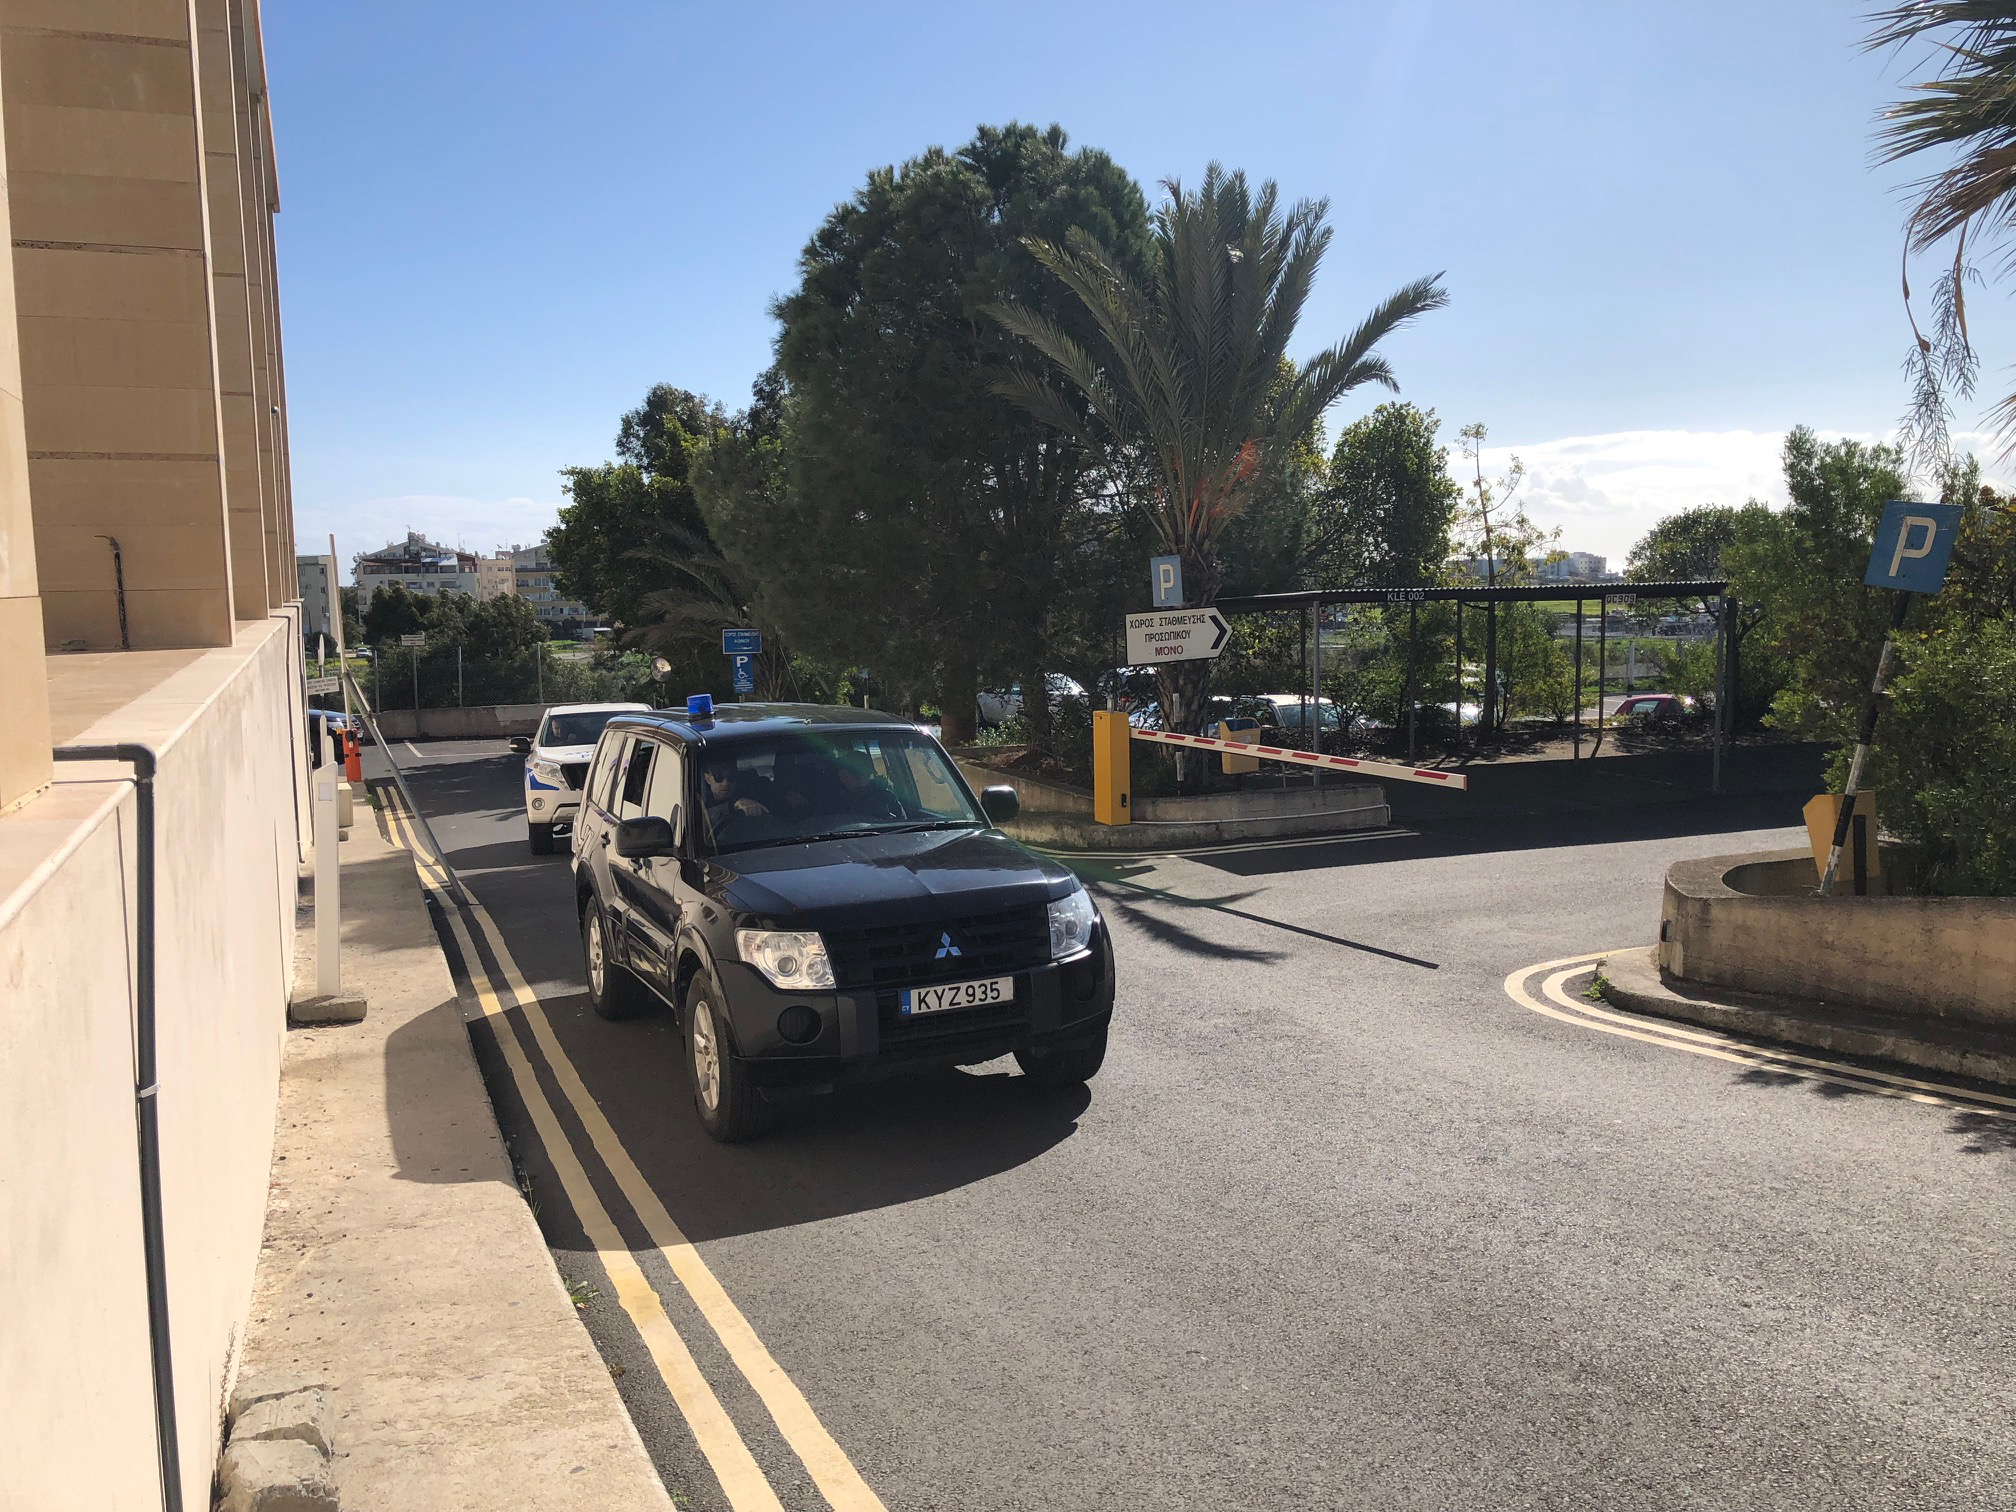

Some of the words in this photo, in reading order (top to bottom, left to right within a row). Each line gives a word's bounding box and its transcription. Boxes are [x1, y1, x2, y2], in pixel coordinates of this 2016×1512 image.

[1888, 515, 1937, 577] P
[1159, 564, 1174, 600] P
[1387, 592, 1406, 601] KLE
[1408, 591, 1425, 601] 002
[1129, 618, 1154, 629] ΧΩΡΟΣ
[1159, 614, 1206, 627] ΣΤΑΘΜΕΥΣΗΣ
[1144, 630, 1191, 643] ΠΡΟΣΩΠΙΚΟΥ
[1155, 645, 1184, 656] ΜΟΝΟ
[736, 656, 749, 667] P
[917, 981, 1000, 1011] KYZ935
